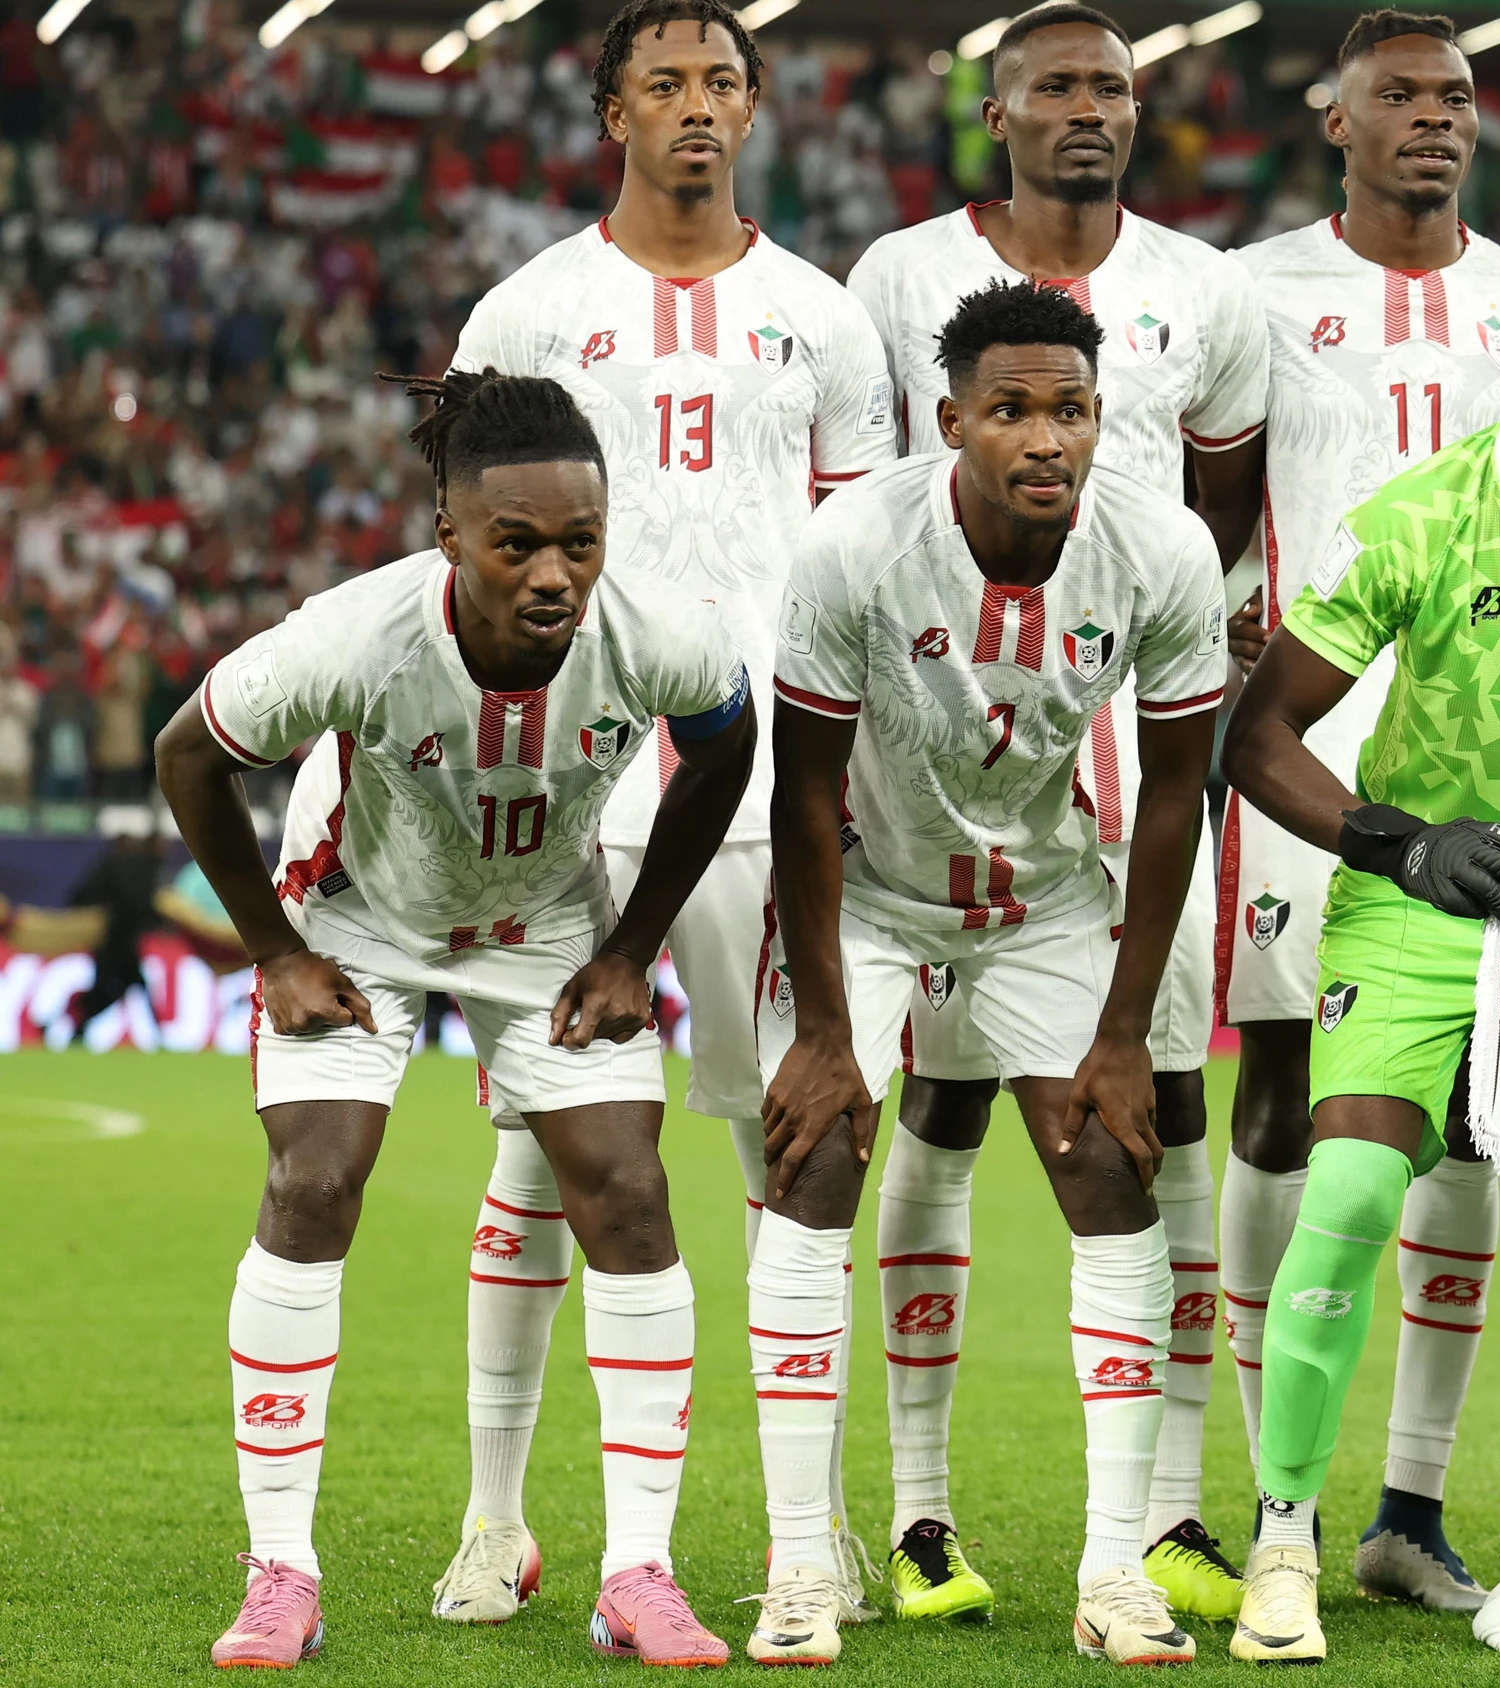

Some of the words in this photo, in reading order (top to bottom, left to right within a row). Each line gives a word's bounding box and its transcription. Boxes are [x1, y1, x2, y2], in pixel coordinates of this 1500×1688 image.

[655, 393, 714, 473] 13
[1390, 382, 1442, 457] 11
[980, 703, 1016, 770] 7
[477, 793, 548, 860] 10
